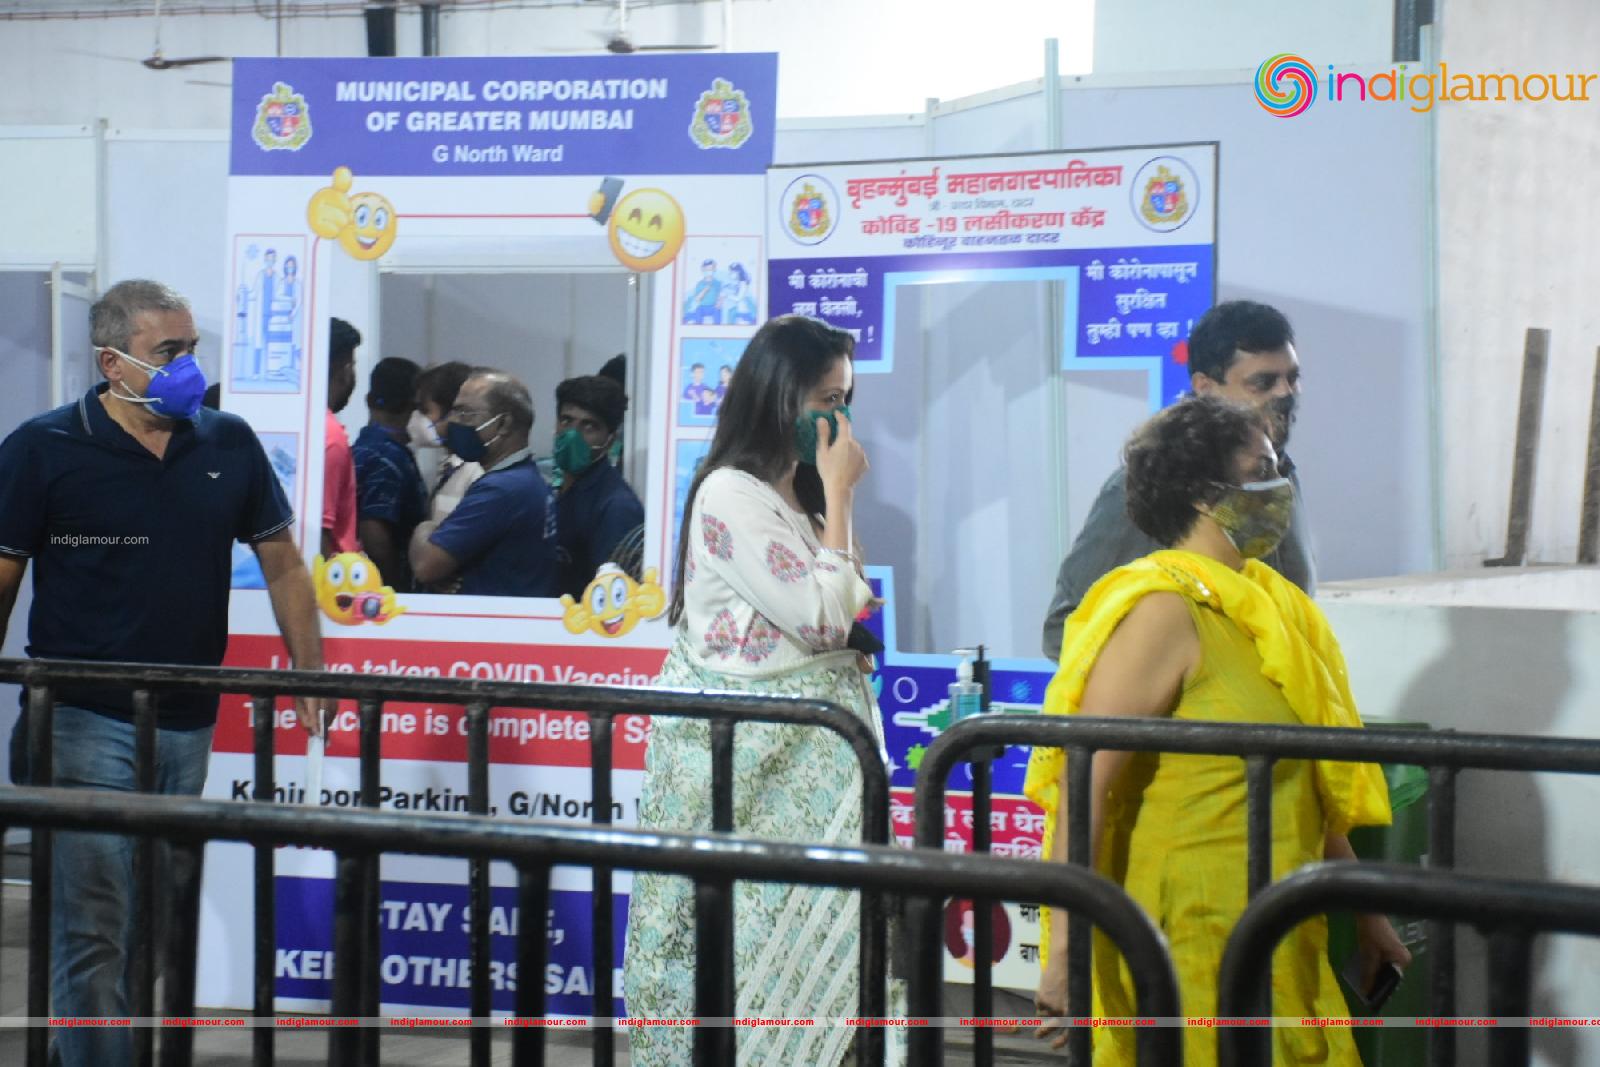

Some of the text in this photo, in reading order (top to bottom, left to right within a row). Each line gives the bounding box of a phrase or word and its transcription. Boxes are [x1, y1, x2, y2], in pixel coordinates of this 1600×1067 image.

[336, 78, 668, 102] MUNICIPAL CORPORATION
[366, 109, 634, 132] OF GREATER MUMBAI
[432, 144, 564, 163] G North Ward
[424, 708, 448, 735] is
[379, 900, 453, 932] TAY
